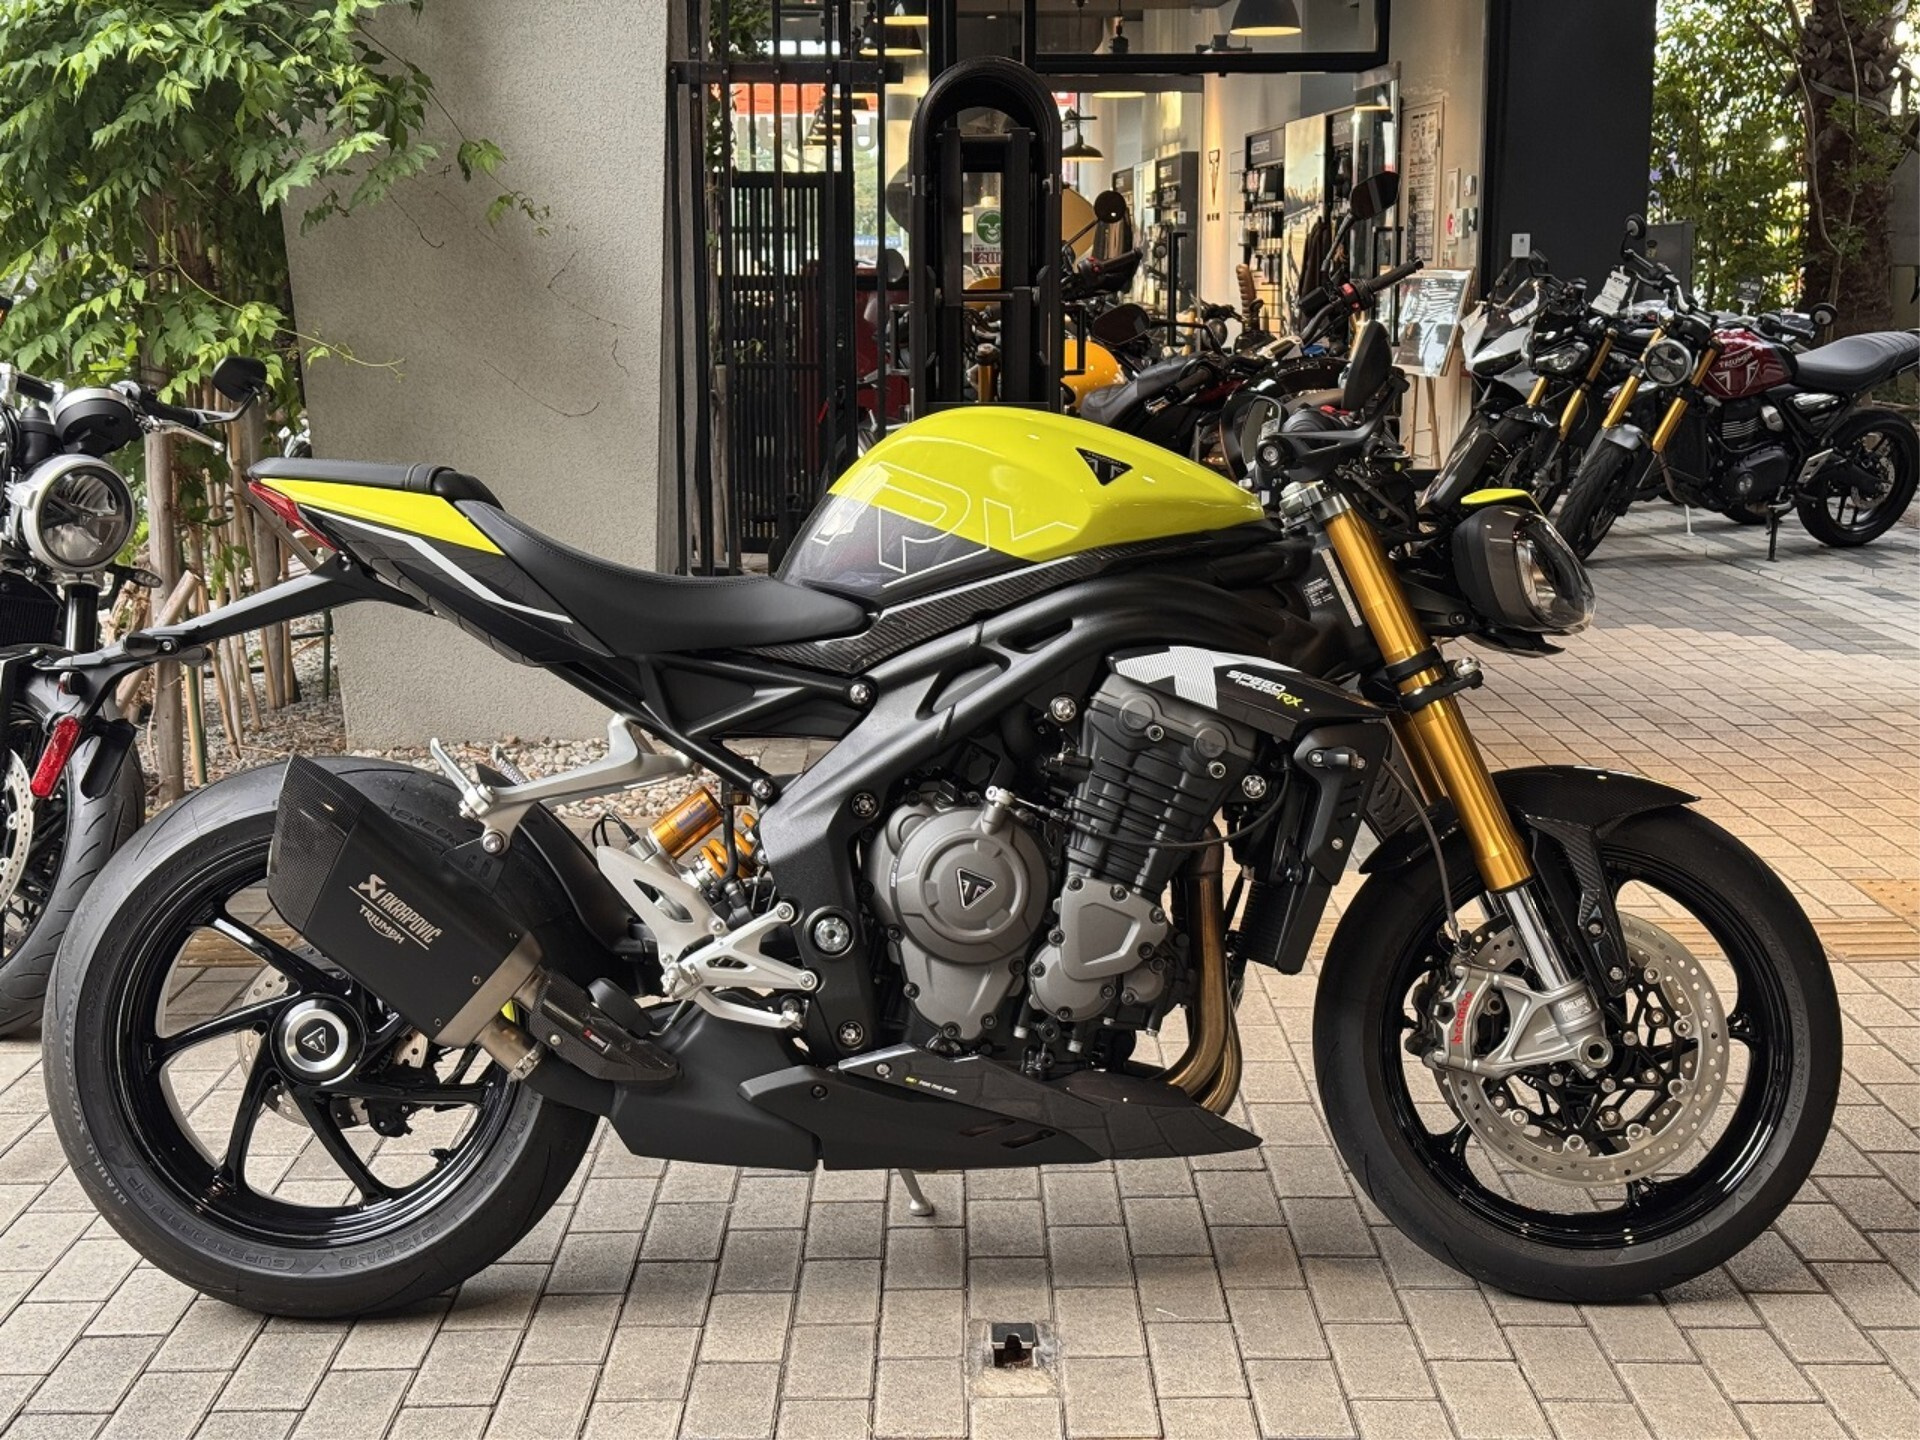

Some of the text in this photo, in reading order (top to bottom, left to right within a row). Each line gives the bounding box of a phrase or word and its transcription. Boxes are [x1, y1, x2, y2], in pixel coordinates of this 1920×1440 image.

[1226, 670, 1286, 692] SPEED
[1276, 692, 1303, 707] RX
[359, 904, 405, 944] TRIUMPH
[1451, 991, 1474, 1045] brembo
[86, 1142, 128, 1206] DIABLO
